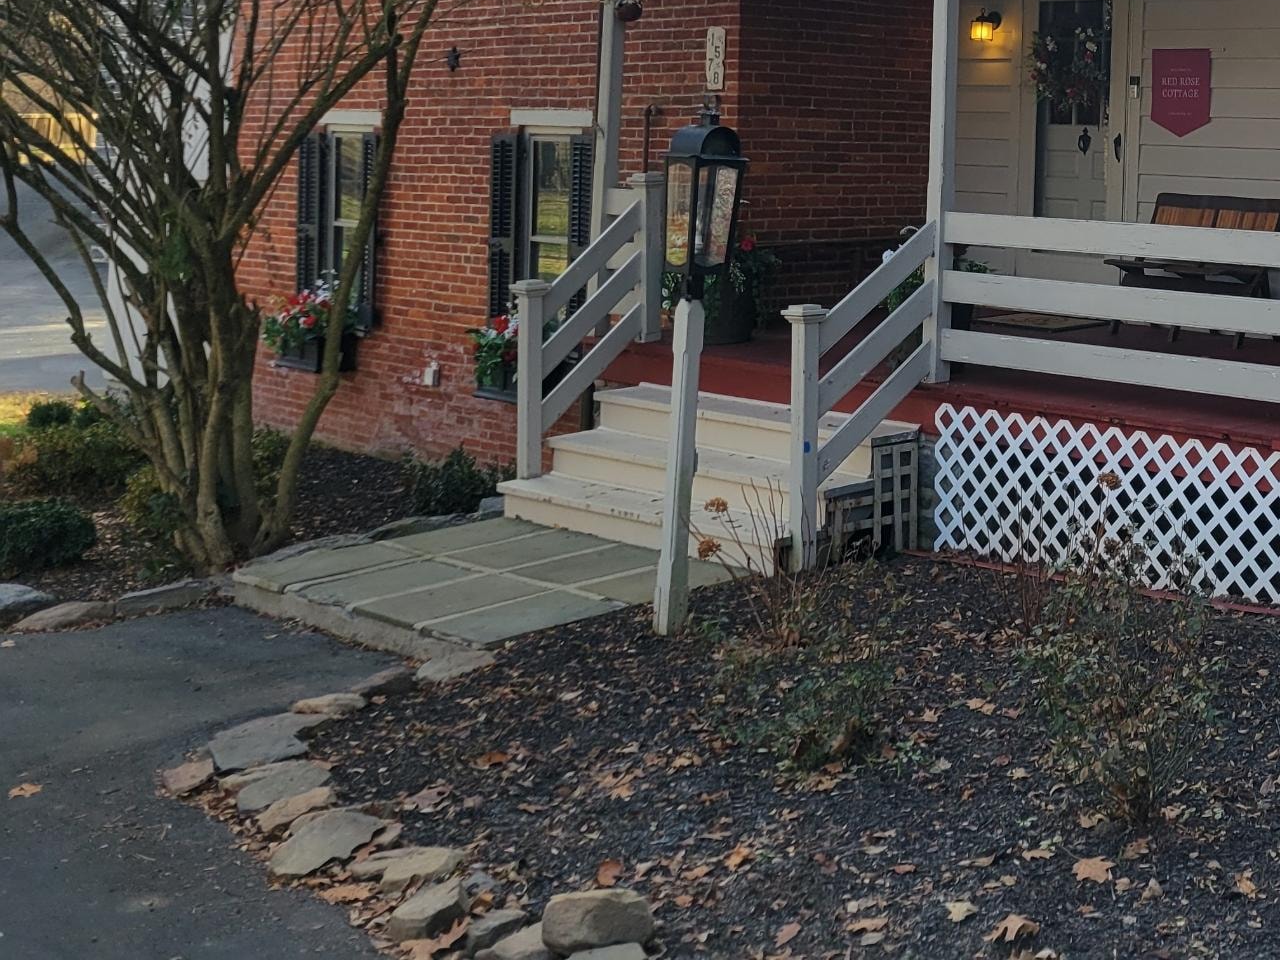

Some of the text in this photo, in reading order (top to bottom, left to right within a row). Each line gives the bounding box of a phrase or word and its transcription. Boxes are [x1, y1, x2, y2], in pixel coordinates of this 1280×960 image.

[1161, 77, 1200, 86] RED ROSE
[1162, 89, 1199, 98] COTTAGE
